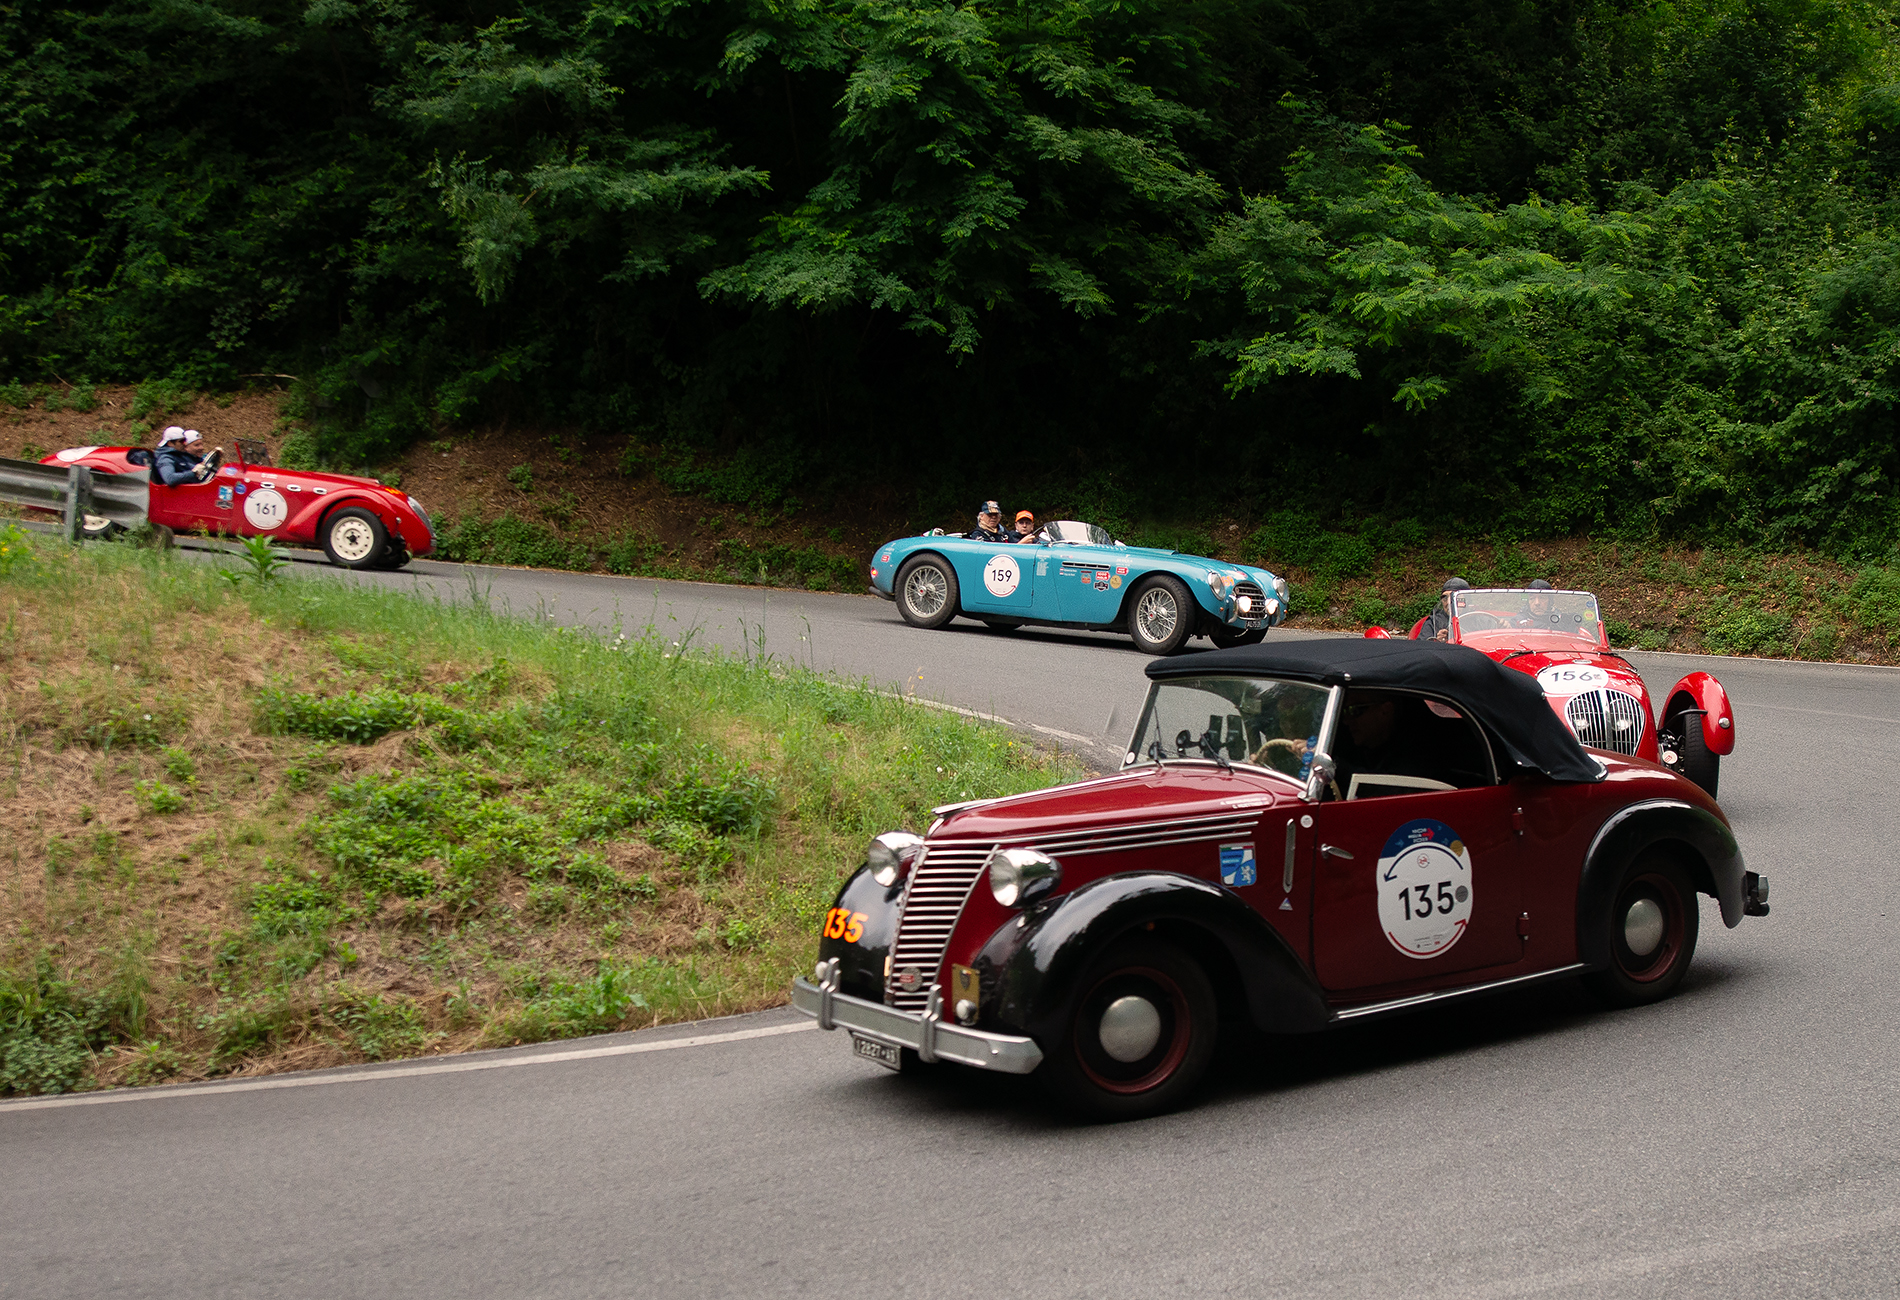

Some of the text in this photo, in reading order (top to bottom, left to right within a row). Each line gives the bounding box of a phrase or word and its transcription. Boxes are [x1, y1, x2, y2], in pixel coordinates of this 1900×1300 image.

[255, 502, 277, 516] 161
[991, 569, 1013, 583] 159
[1551, 671, 1593, 682] 156
[1398, 881, 1455, 921] 135
[823, 907, 869, 944] 135
